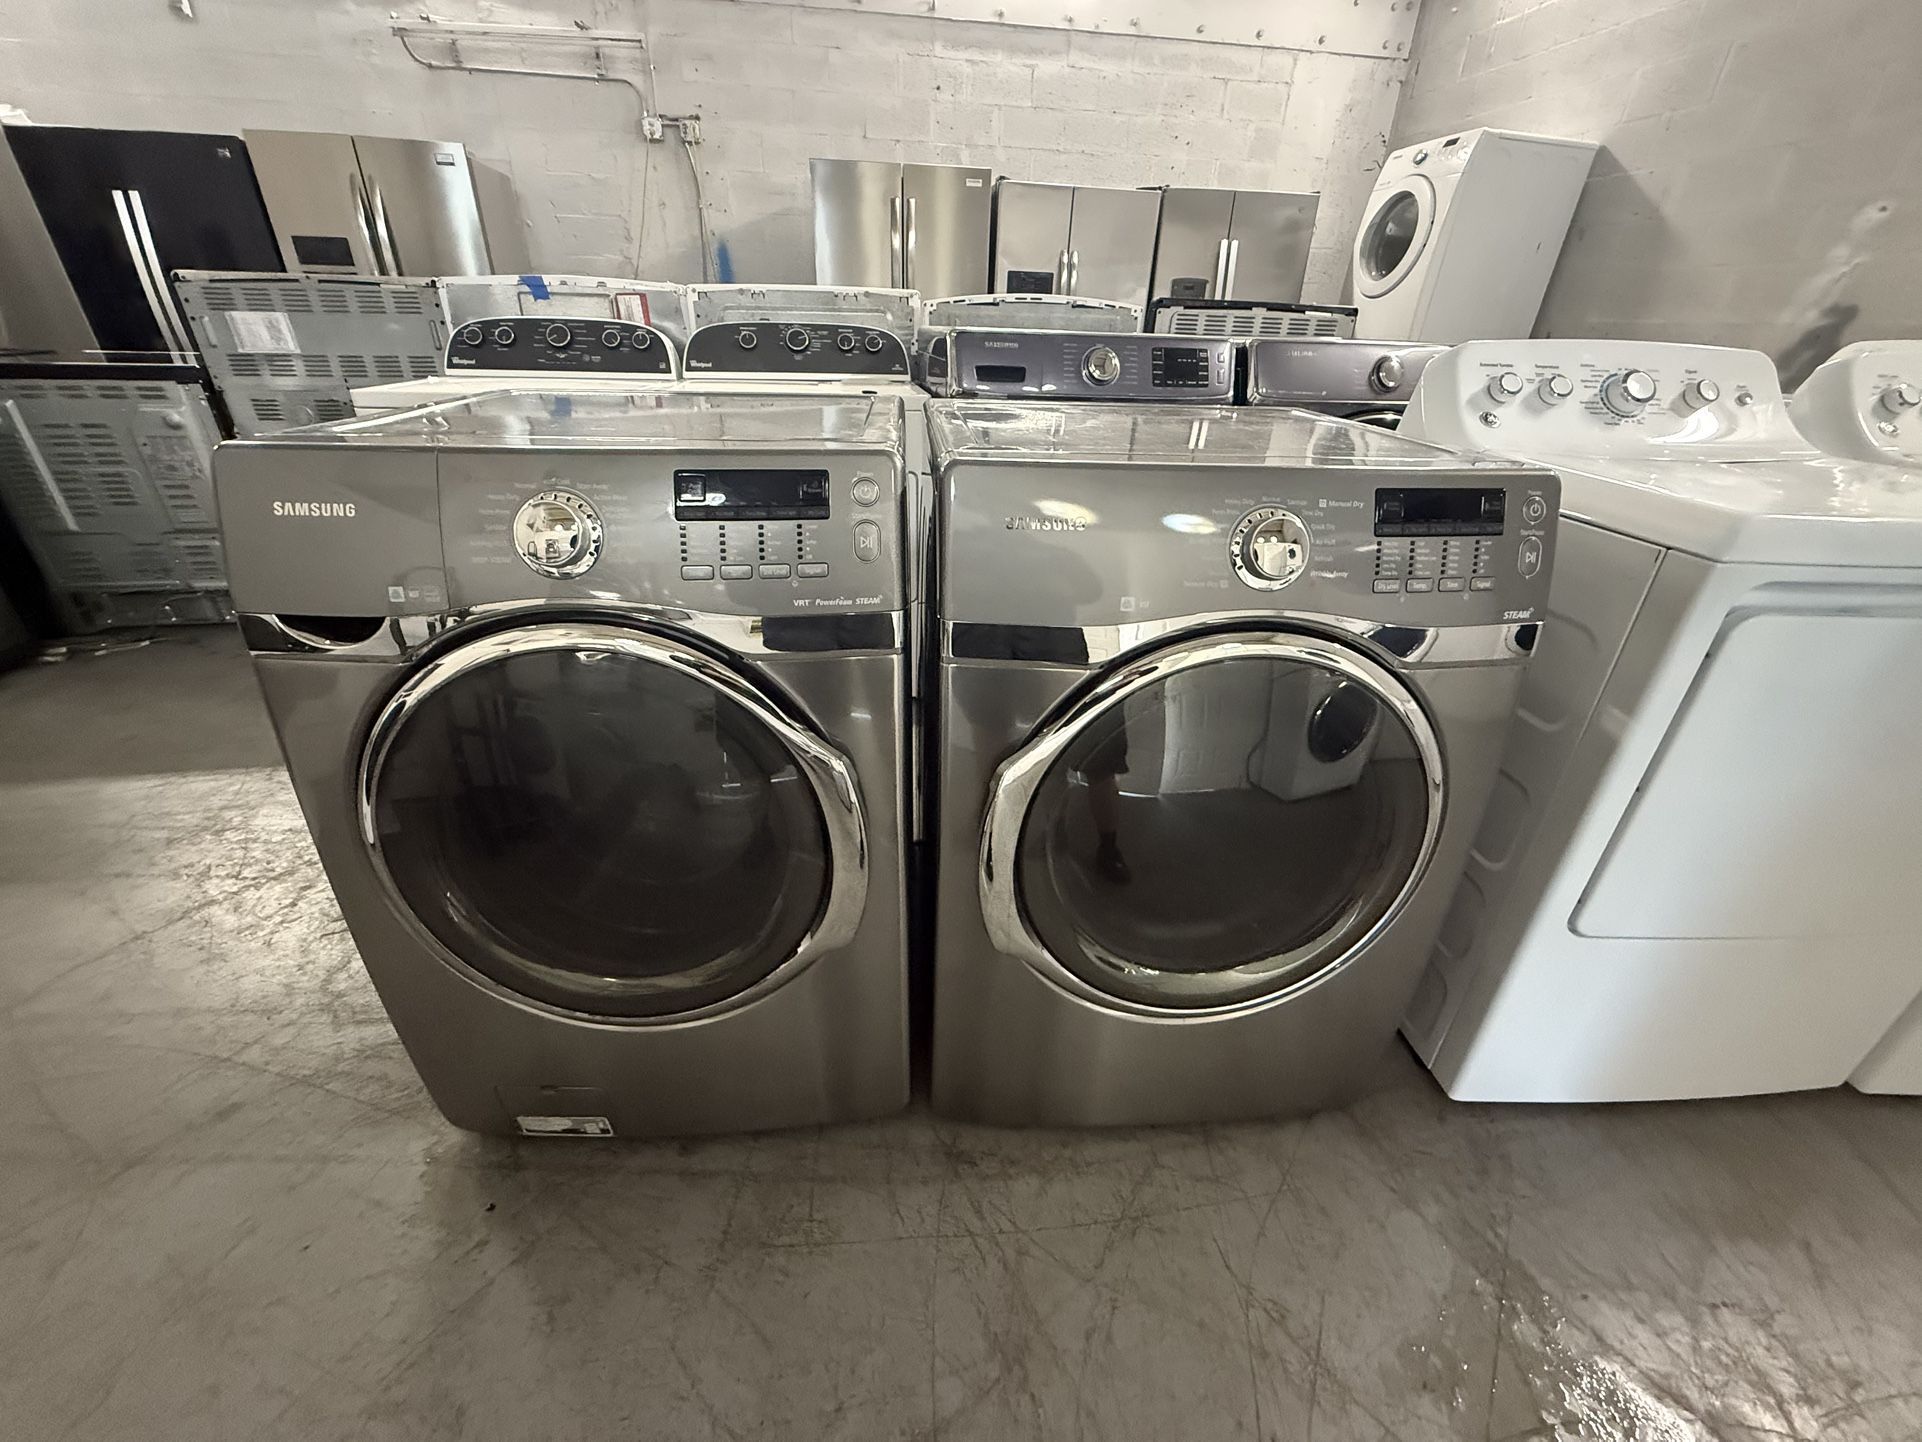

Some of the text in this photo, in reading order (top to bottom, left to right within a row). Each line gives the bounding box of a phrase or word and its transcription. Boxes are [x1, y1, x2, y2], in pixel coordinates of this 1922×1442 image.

[272, 500, 356, 517] SAMSUNG
[1328, 500, 1364, 509] Manual Dry
[1005, 516, 1087, 531] SAMSUNG
[793, 597, 880, 607] VRT PowerFoam STEAM
[1503, 610, 1531, 620] STEAM
